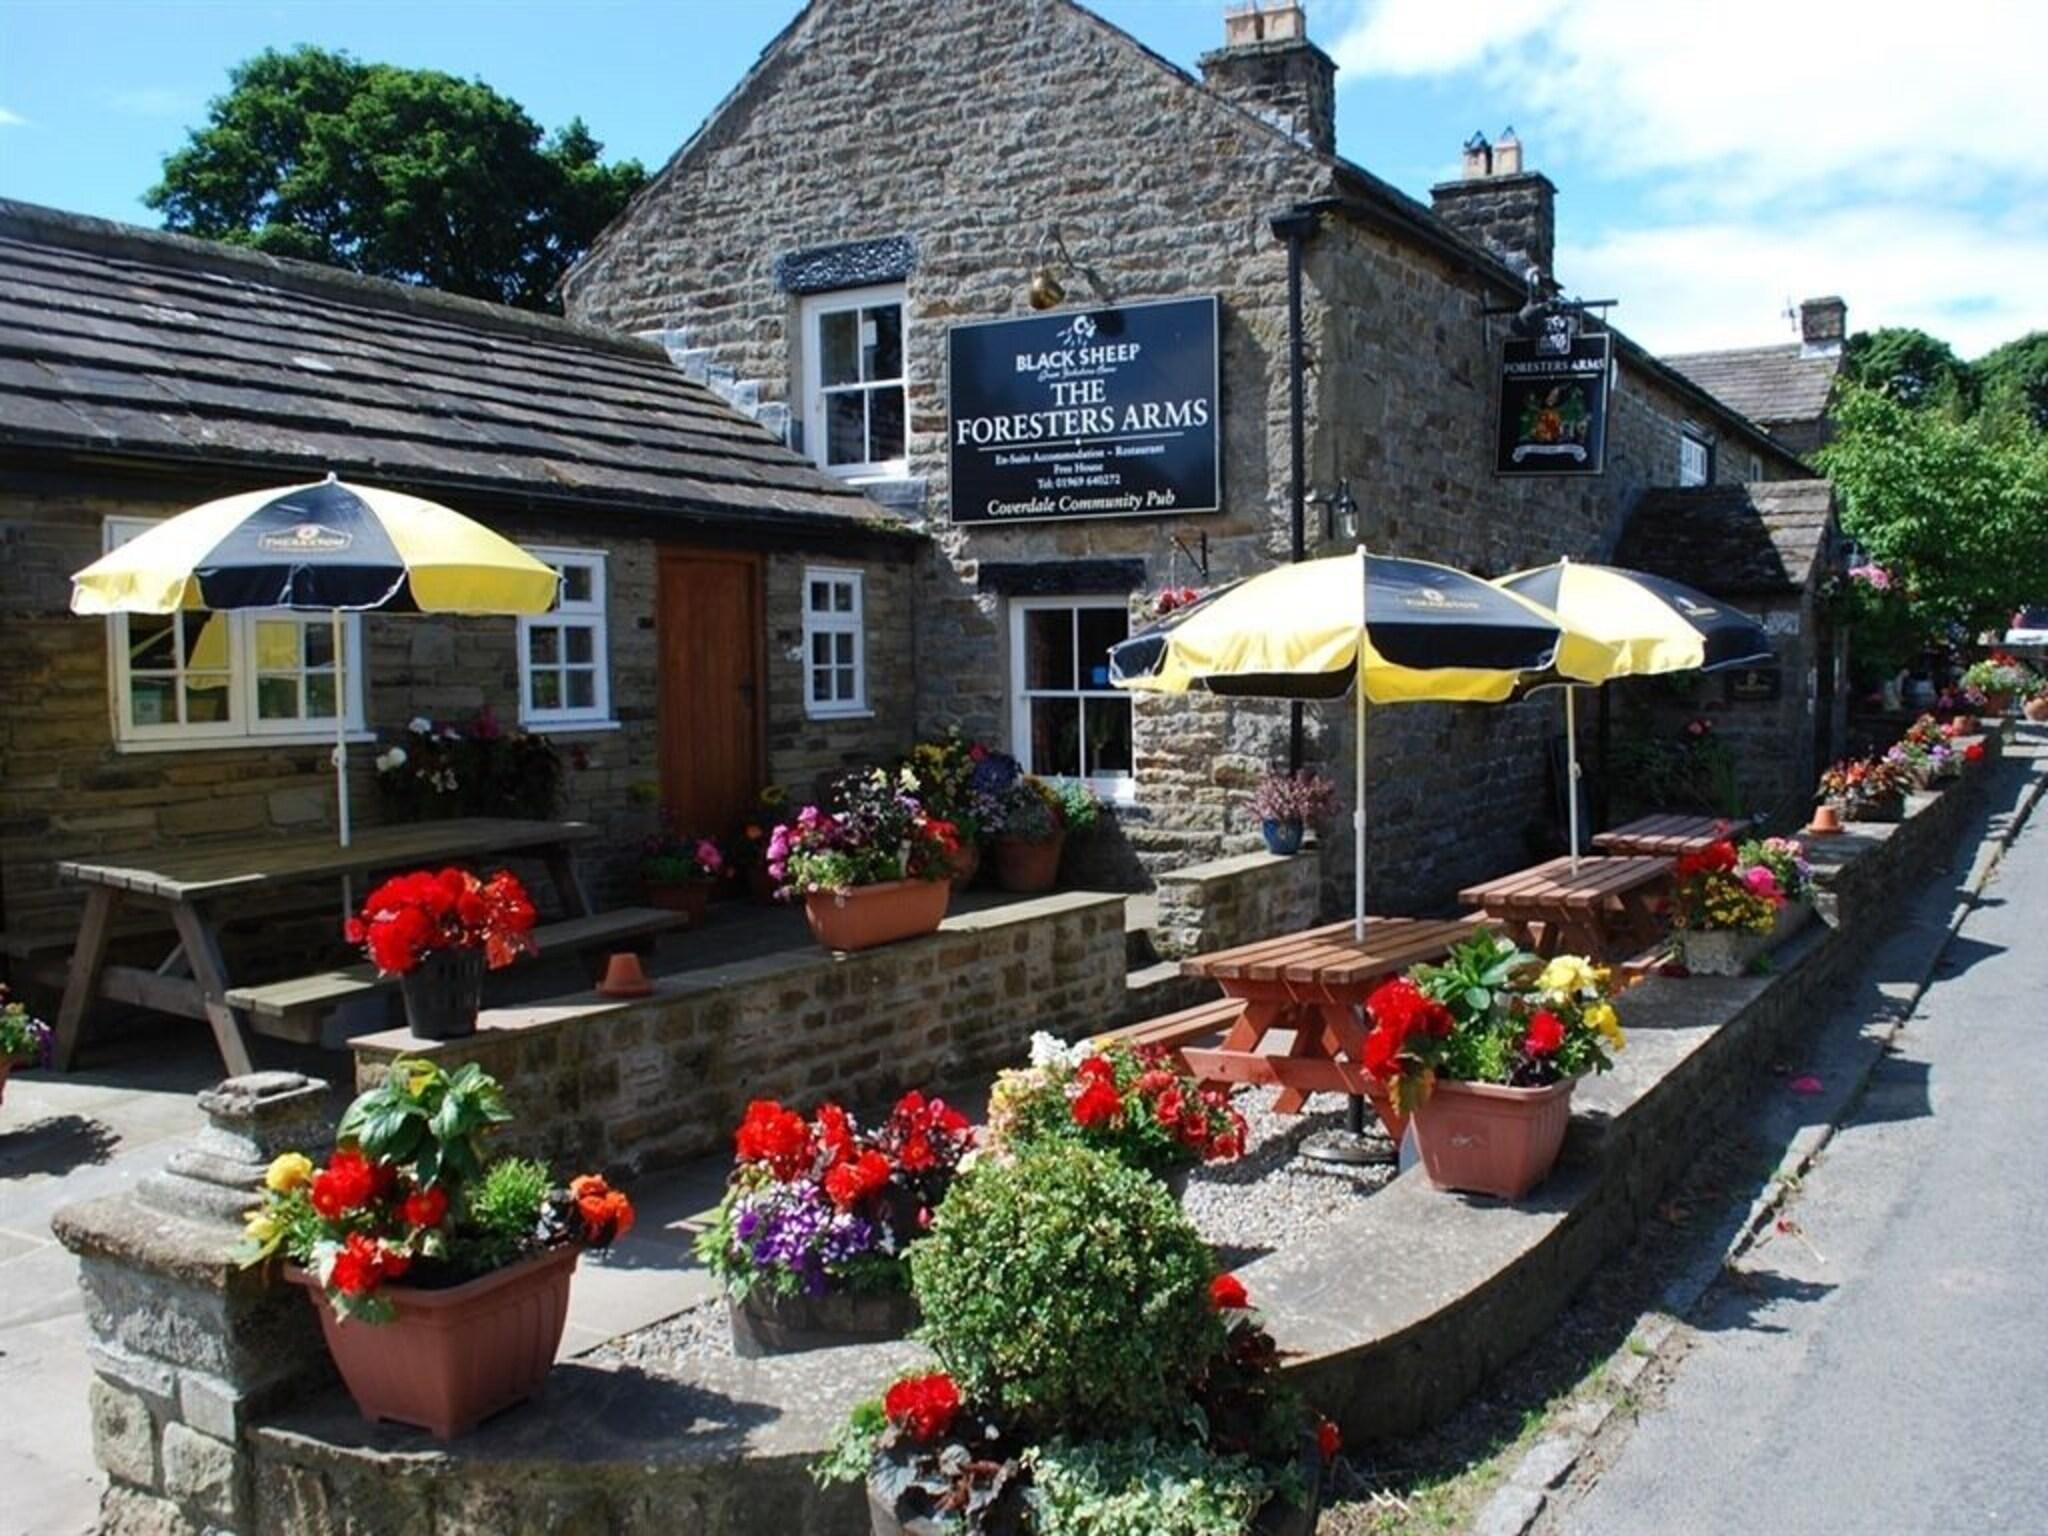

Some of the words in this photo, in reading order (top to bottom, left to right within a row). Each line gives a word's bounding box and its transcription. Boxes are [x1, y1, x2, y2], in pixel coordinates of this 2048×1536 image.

[1016, 351, 1075, 372] BLACK
[1079, 343, 1141, 365] SHEEP
[1503, 360, 1568, 374] FORESTERS
[1050, 379, 1107, 407] THE
[957, 405, 1115, 445] FORESTERS
[1121, 398, 1209, 432] ARMS
[1075, 462, 1103, 474] House
[987, 497, 1055, 516] Coverdale
[1059, 492, 1143, 513] Community
[1146, 489, 1176, 507] Pub
